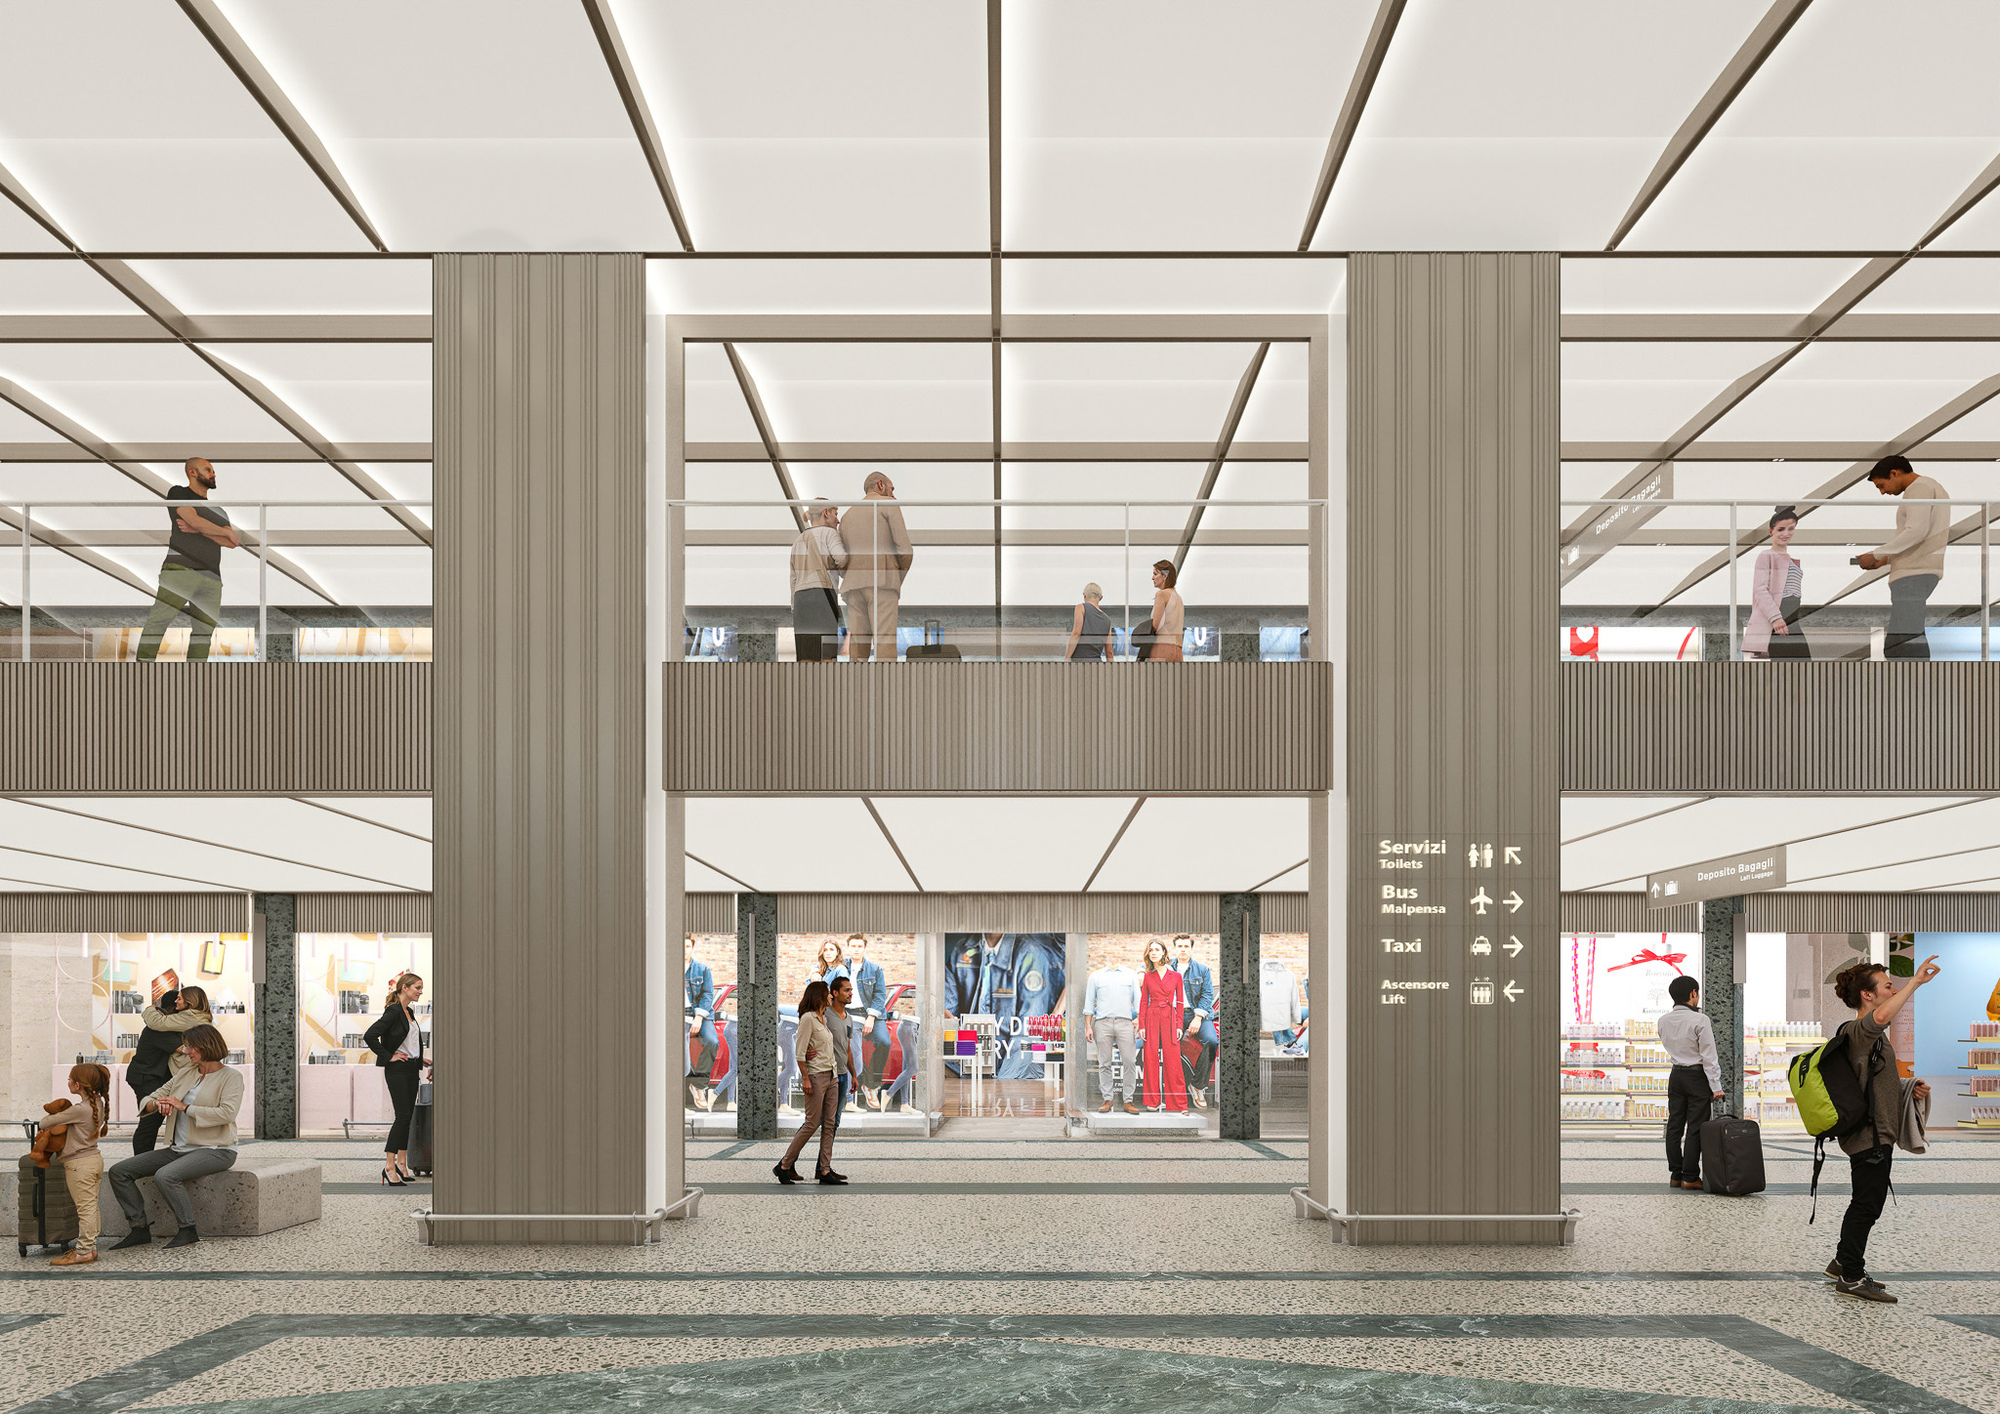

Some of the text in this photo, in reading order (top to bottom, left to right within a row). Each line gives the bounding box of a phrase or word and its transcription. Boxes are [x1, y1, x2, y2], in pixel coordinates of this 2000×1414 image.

[1596, 505, 1629, 535] Deposito
[1379, 839, 1447, 855] Servizi
[1379, 858, 1424, 869] Toilets
[1697, 857, 1774, 881] Deposito Bagagli
[1751, 870, 1774, 880] Luggage
[1381, 884, 1418, 899] Bus
[1381, 903, 1446, 916] Malpensa
[1381, 938, 1422, 953] Taxi
[1381, 979, 1450, 990] Ascensore
[1381, 993, 1406, 1005] Lift
